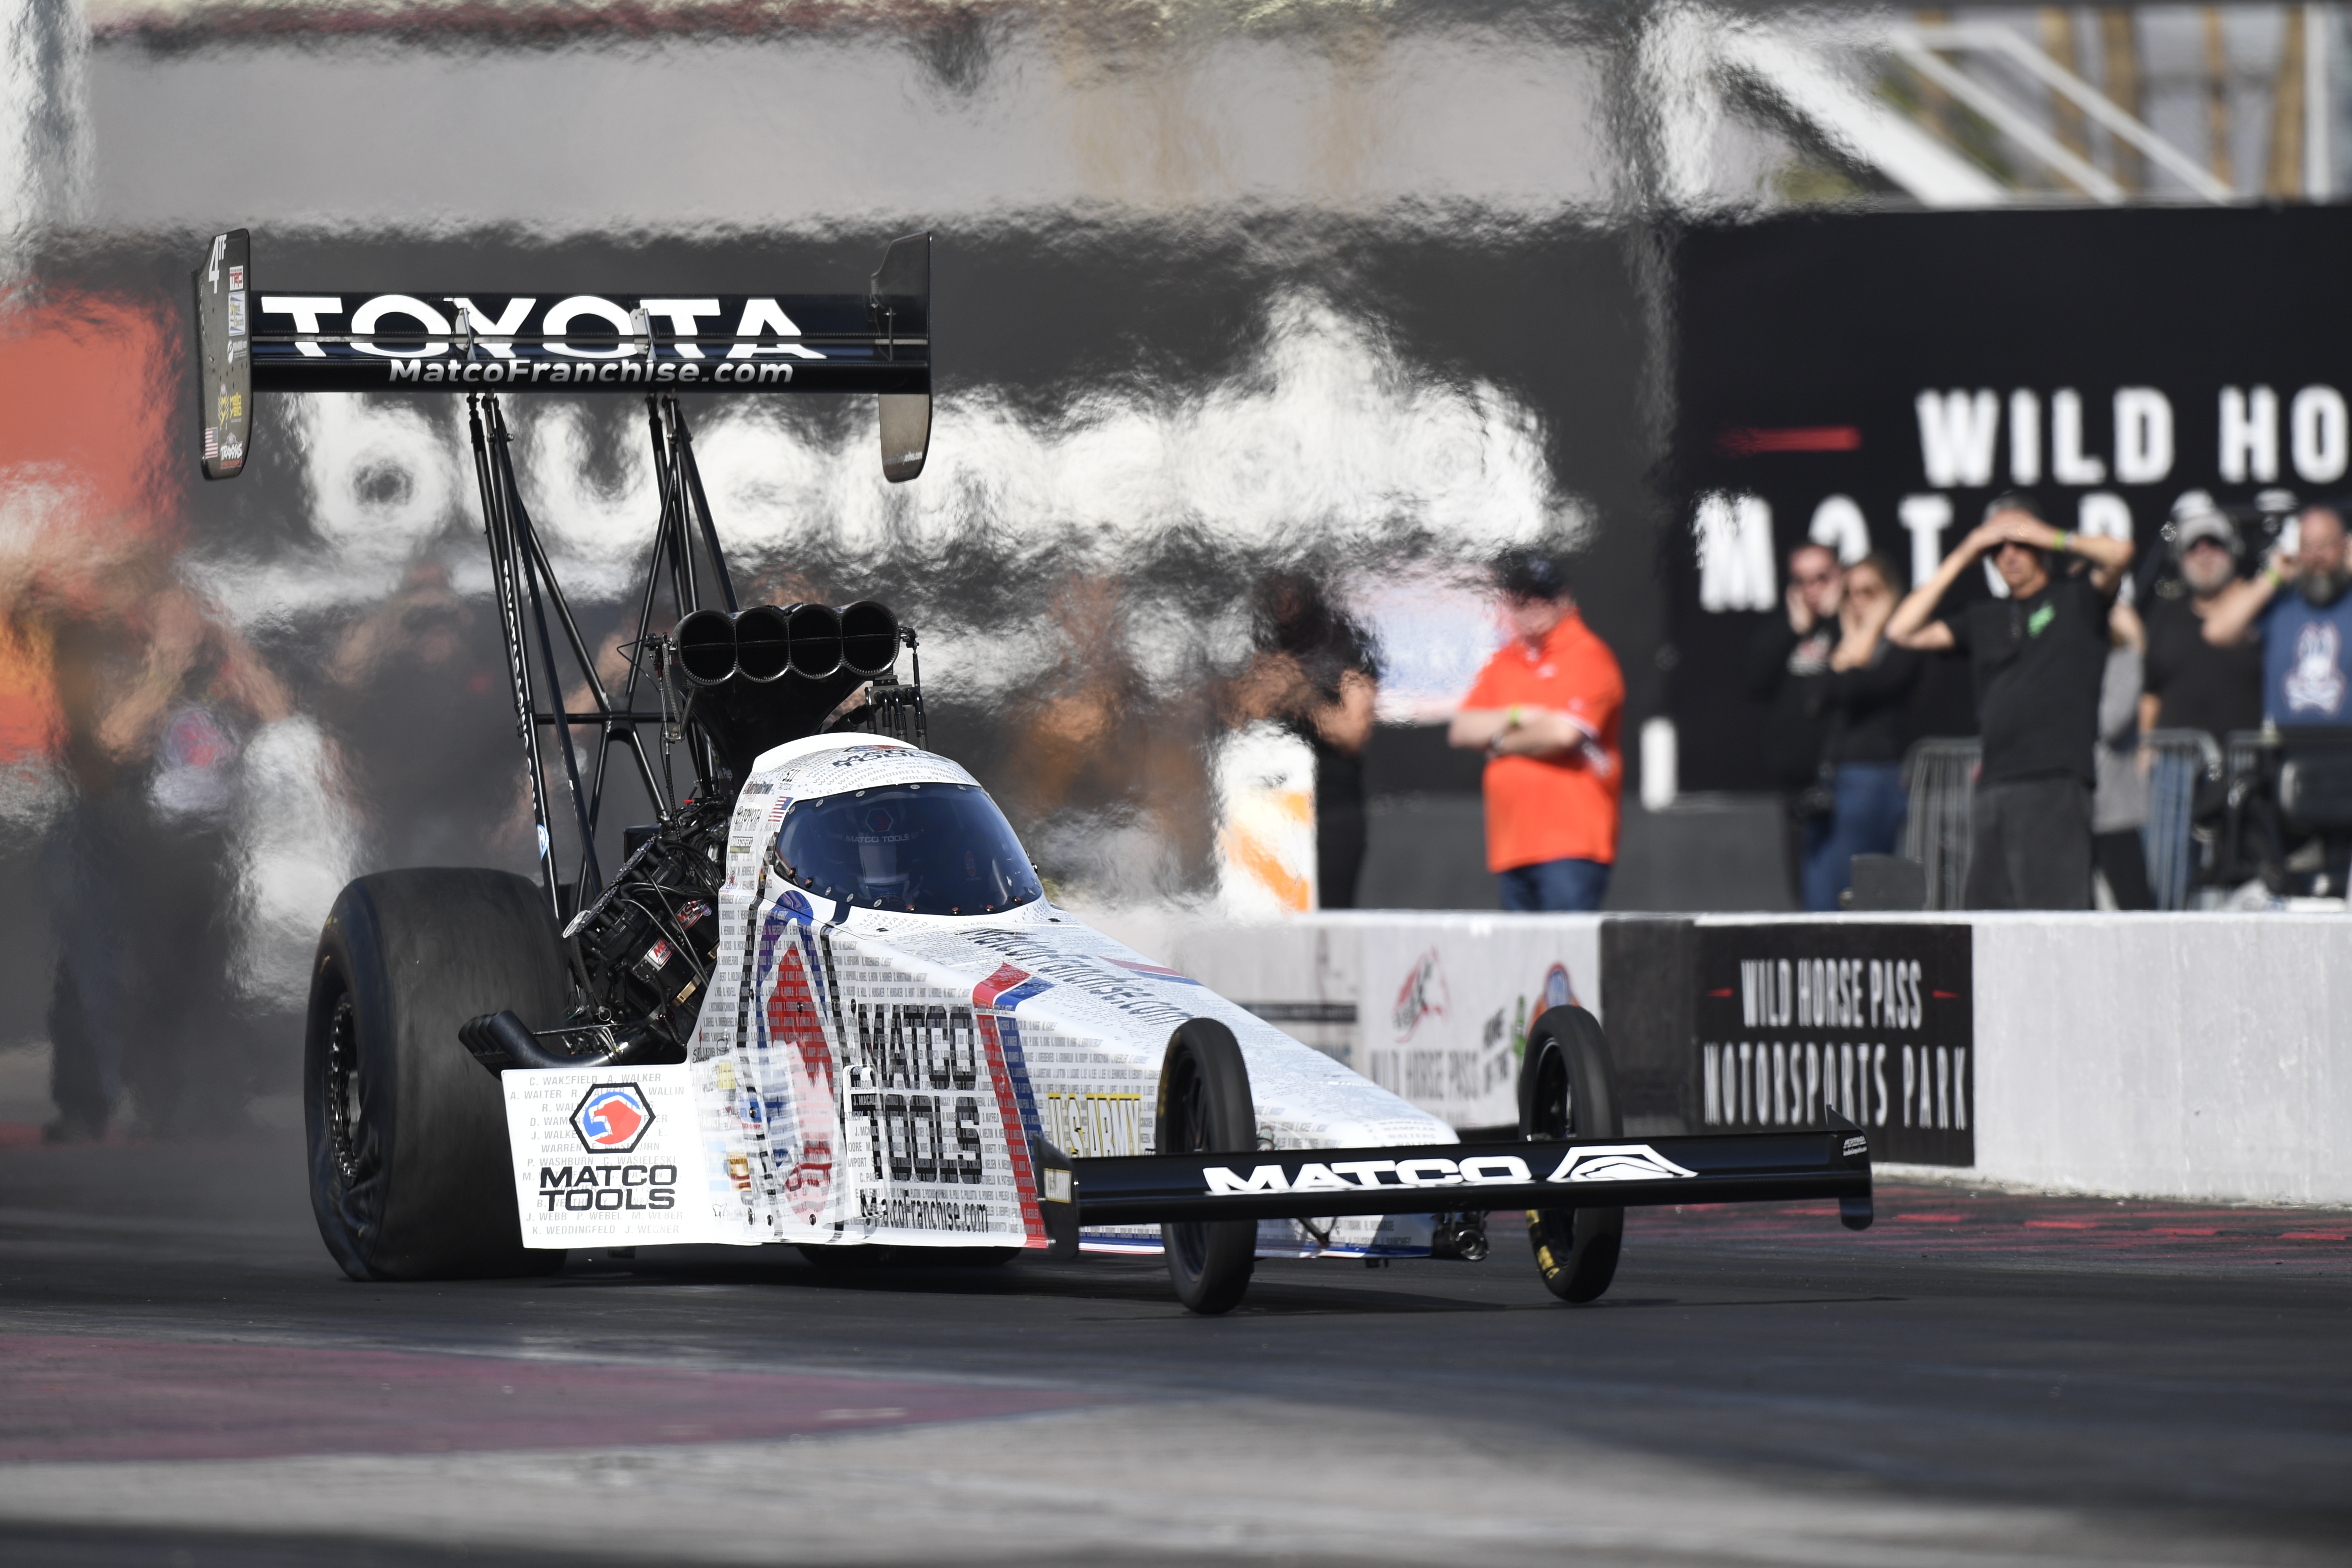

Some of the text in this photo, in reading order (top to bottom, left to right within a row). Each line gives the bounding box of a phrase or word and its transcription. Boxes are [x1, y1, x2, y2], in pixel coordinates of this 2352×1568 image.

[260, 294, 828, 359] TOYOTA
[389, 359, 794, 383] MatcoFranchise.com
[1915, 386, 2175, 487] WILD
[742, 808, 762, 823] TOYOTA
[882, 834, 909, 842] TOOLS
[1740, 958, 1922, 1030] WILD HORSE PASS
[858, 1004, 977, 1091] MATCO
[529, 1077, 539, 1086] C.
[543, 1075, 597, 1085] WAKEFIELD
[621, 1073, 661, 1083] WALKER
[1703, 1042, 1967, 1130] MOTORSPORTS PARK
[510, 1092, 520, 1100] A.
[524, 1090, 561, 1099] WALTER
[572, 1089, 580, 1098] R.
[648, 1086, 684, 1095] WALLIN
[542, 1104, 551, 1112] R.
[530, 1118, 539, 1126] D.
[1085, 1093, 1141, 1157] ARMY
[531, 1131, 539, 1140] J.
[850, 1093, 983, 1184] TOOLS
[541, 1143, 582, 1153] WARREN
[527, 1158, 535, 1167] P.
[539, 1157, 593, 1166] WASHBURN
[617, 1156, 675, 1165] WASIELESKI
[540, 1164, 677, 1188] MATCO
[1203, 1156, 1534, 1196] MATCO
[539, 1188, 675, 1212] TOOLS
[526, 1211, 683, 1221] J. WEBB P. WEBEL M. WEBER
[533, 1225, 679, 1235] K. WEDDINGFELD J. WEGNER
